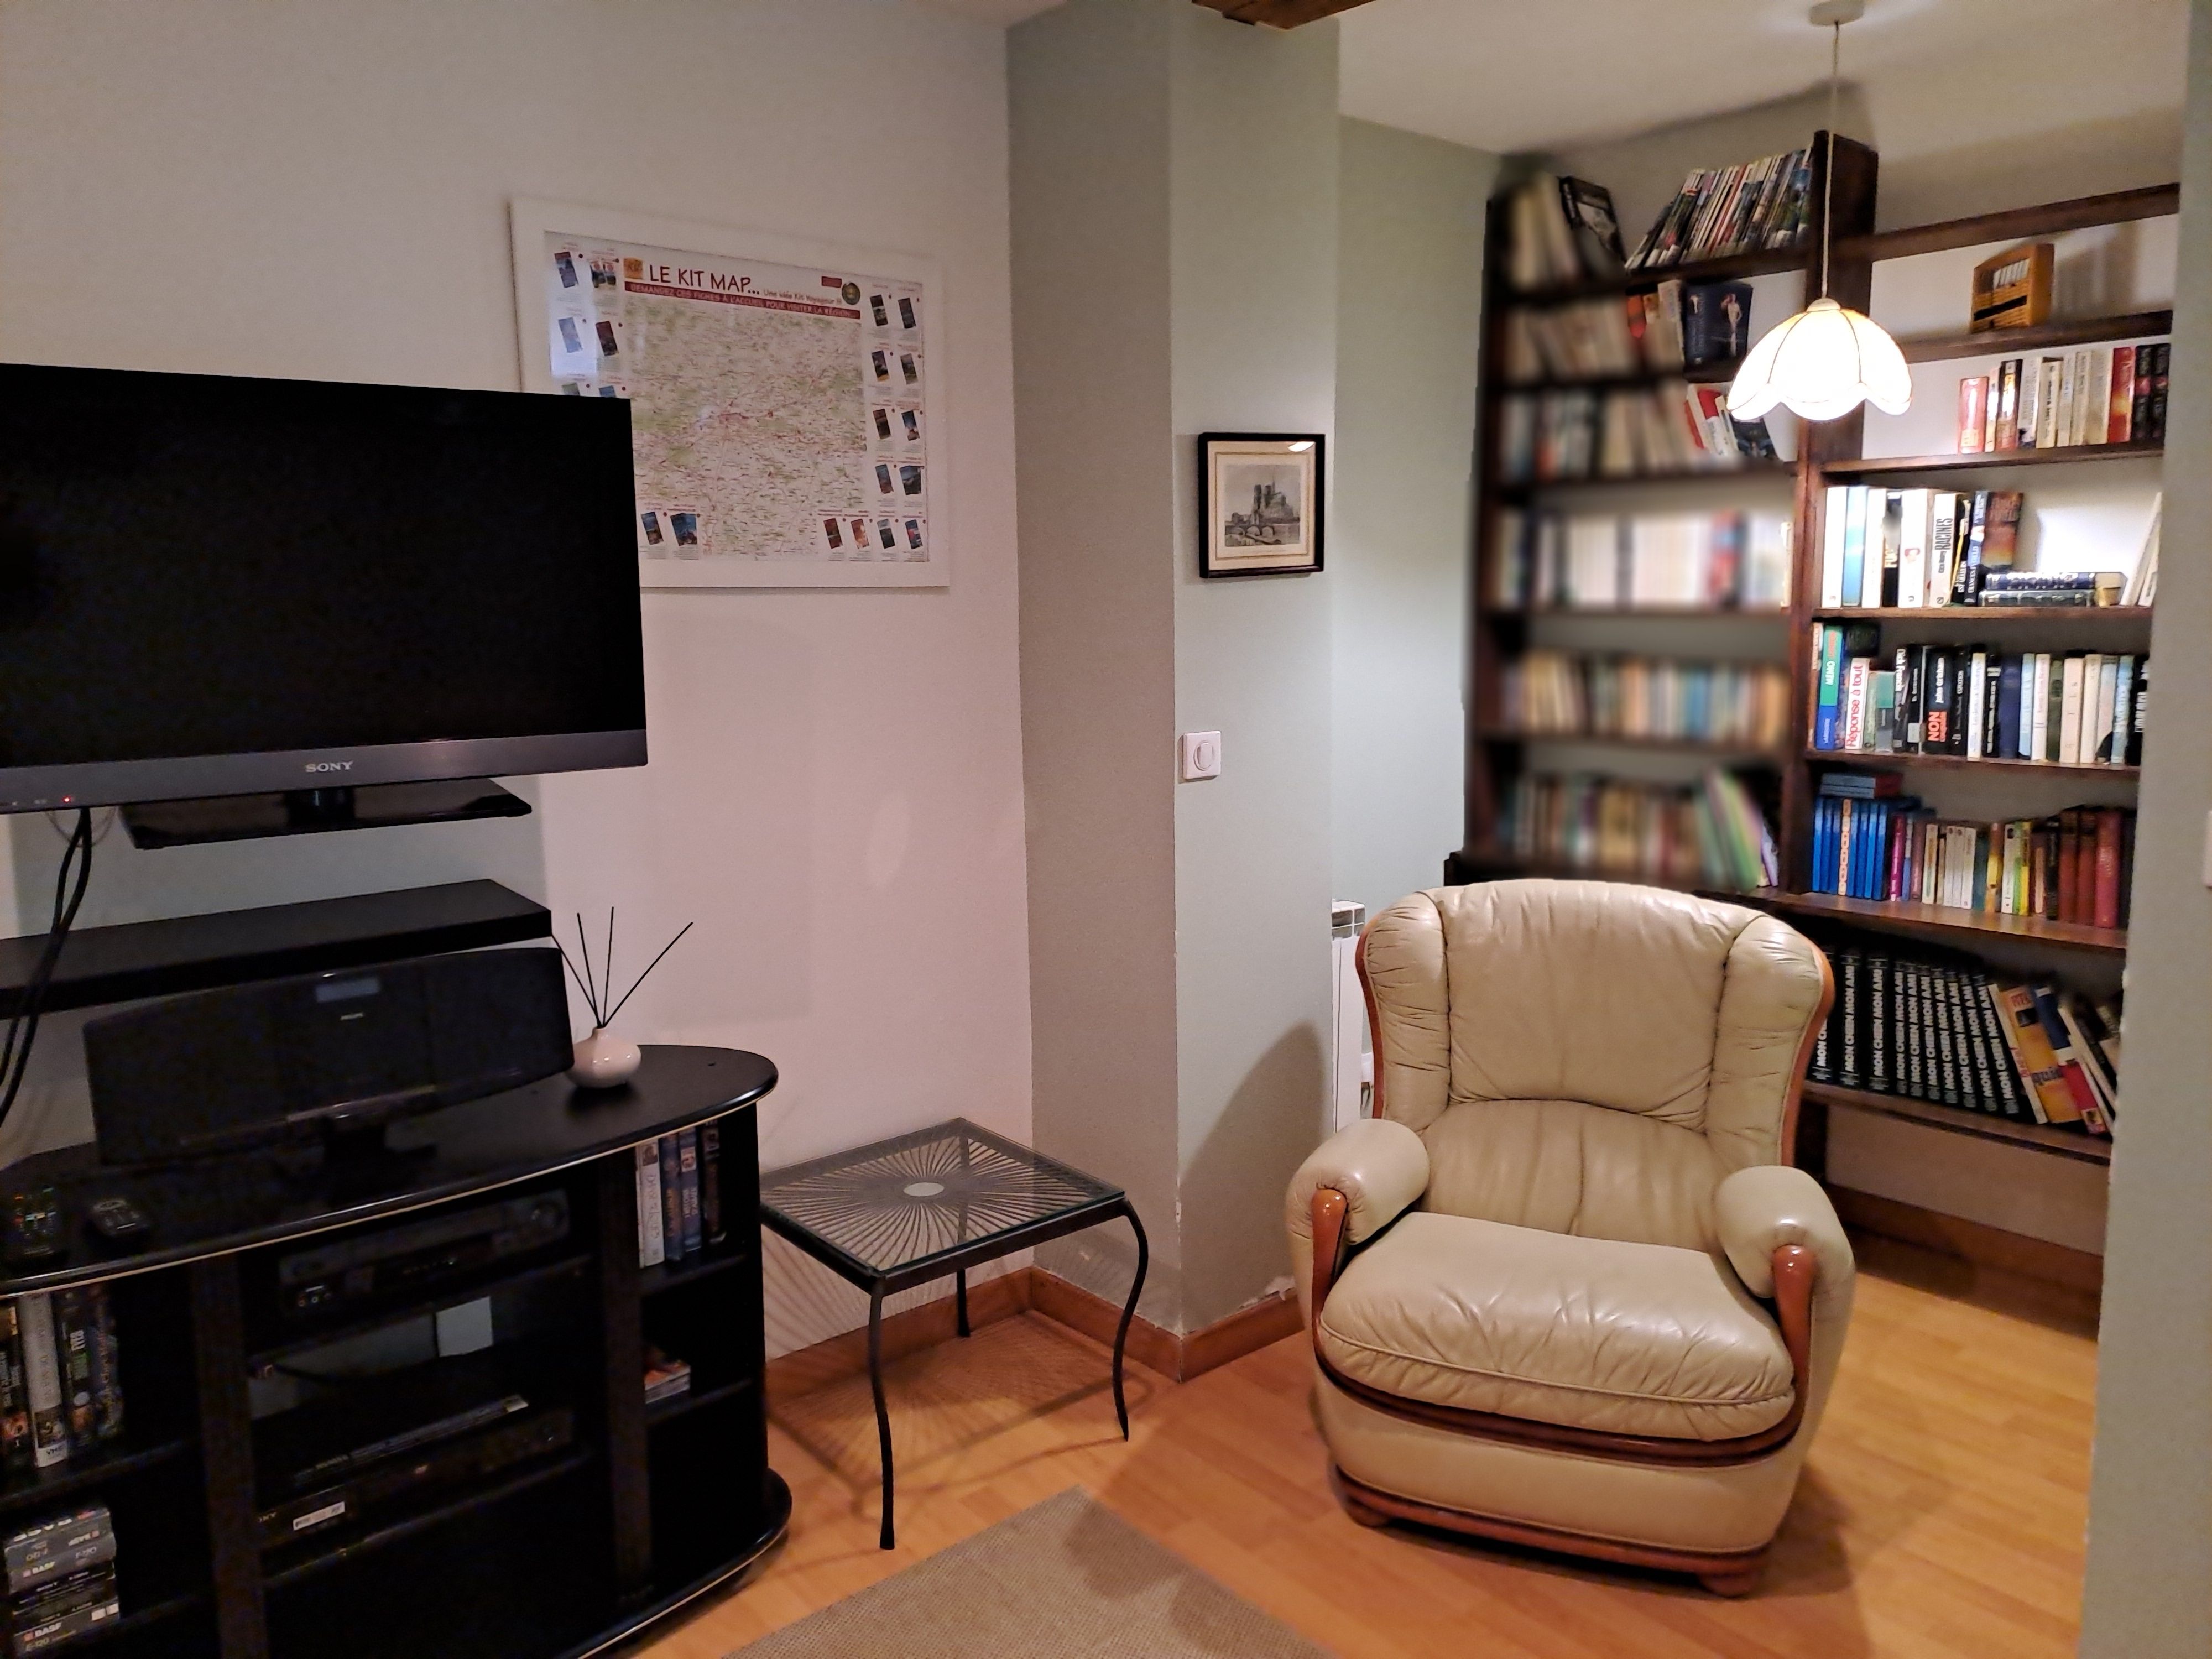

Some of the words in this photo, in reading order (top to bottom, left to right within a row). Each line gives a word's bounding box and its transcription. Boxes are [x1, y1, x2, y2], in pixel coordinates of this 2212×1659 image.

[649, 264, 671, 283] LE
[678, 268, 705, 287] KIT
[711, 273, 760, 295] MAP...
[630, 283, 674, 296] DEMANDEZ
[676, 289, 691, 298] CES
[694, 291, 721, 302] FICHES
[765, 301, 786, 310] POUR
[787, 304, 812, 313] VISITER
[813, 306, 823, 314] LA
[1934, 518, 1953, 550] RACINES
[1852, 665, 1863, 686] tout
[1845, 699, 1861, 747] Réponse
[1927, 711, 1940, 742] NON
[305, 759, 354, 773] SONY
[1845, 965, 1854, 988] AMI
[1872, 969, 1882, 991] AMI
[1895, 972, 1903, 994] AMI
[1907, 974, 1917, 996] AMI
[1921, 976, 1932, 998] AMI
[1845, 988, 1854, 1015] MON
[1934, 979, 1945, 1001] AMI
[1948, 982, 1960, 1005] AMI
[1962, 985, 1976, 1008] AMI
[1978, 985, 1991, 1008] AMI
[1873, 992, 1882, 1018] MON
[1895, 994, 1904, 1021] MON
[1908, 997, 1918, 1023] MON
[1922, 999, 1933, 1026] MON
[1936, 1002, 1948, 1029] MON
[1952, 1005, 1964, 1033] MON
[1967, 1009, 1981, 1036] MON
[1984, 1009, 1999, 1037] MON
[1817, 1041, 1827, 1067] MON
[1845, 1046, 1854, 1072] MON
[1874, 1050, 1884, 1077] MON
[1896, 1053, 1905, 1079] MON
[1911, 1056, 1921, 1082] MON
[1927, 1058, 1938, 1086] MON
[1943, 1062, 1955, 1089] MON
[1960, 1066, 1973, 1094] MON
[1979, 1070, 1993, 1097] MON
[1997, 1071, 2014, 1099] MON
[34, 1622, 62, 1637] BASF
